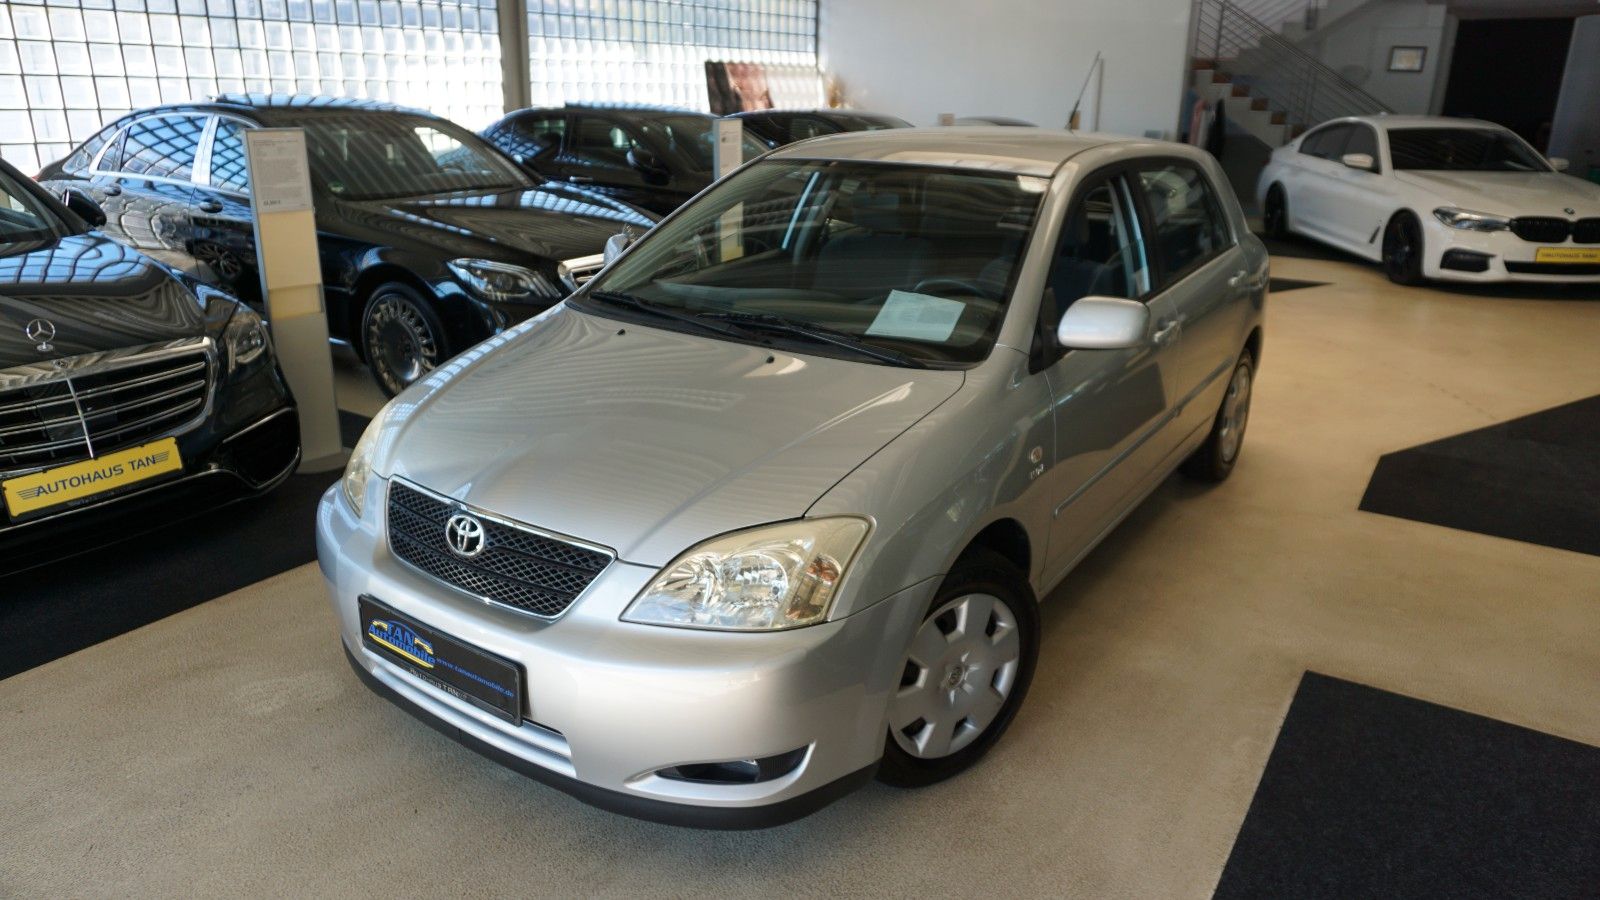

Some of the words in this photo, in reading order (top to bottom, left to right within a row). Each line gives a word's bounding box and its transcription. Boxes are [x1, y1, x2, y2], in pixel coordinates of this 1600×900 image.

[36, 464, 124, 497] AUTOHAUS
[128, 455, 157, 472] TAN
[368, 624, 436, 665] Automobile
[387, 623, 416, 647] TAN
[436, 657, 515, 698] www.tanautomobile.de
